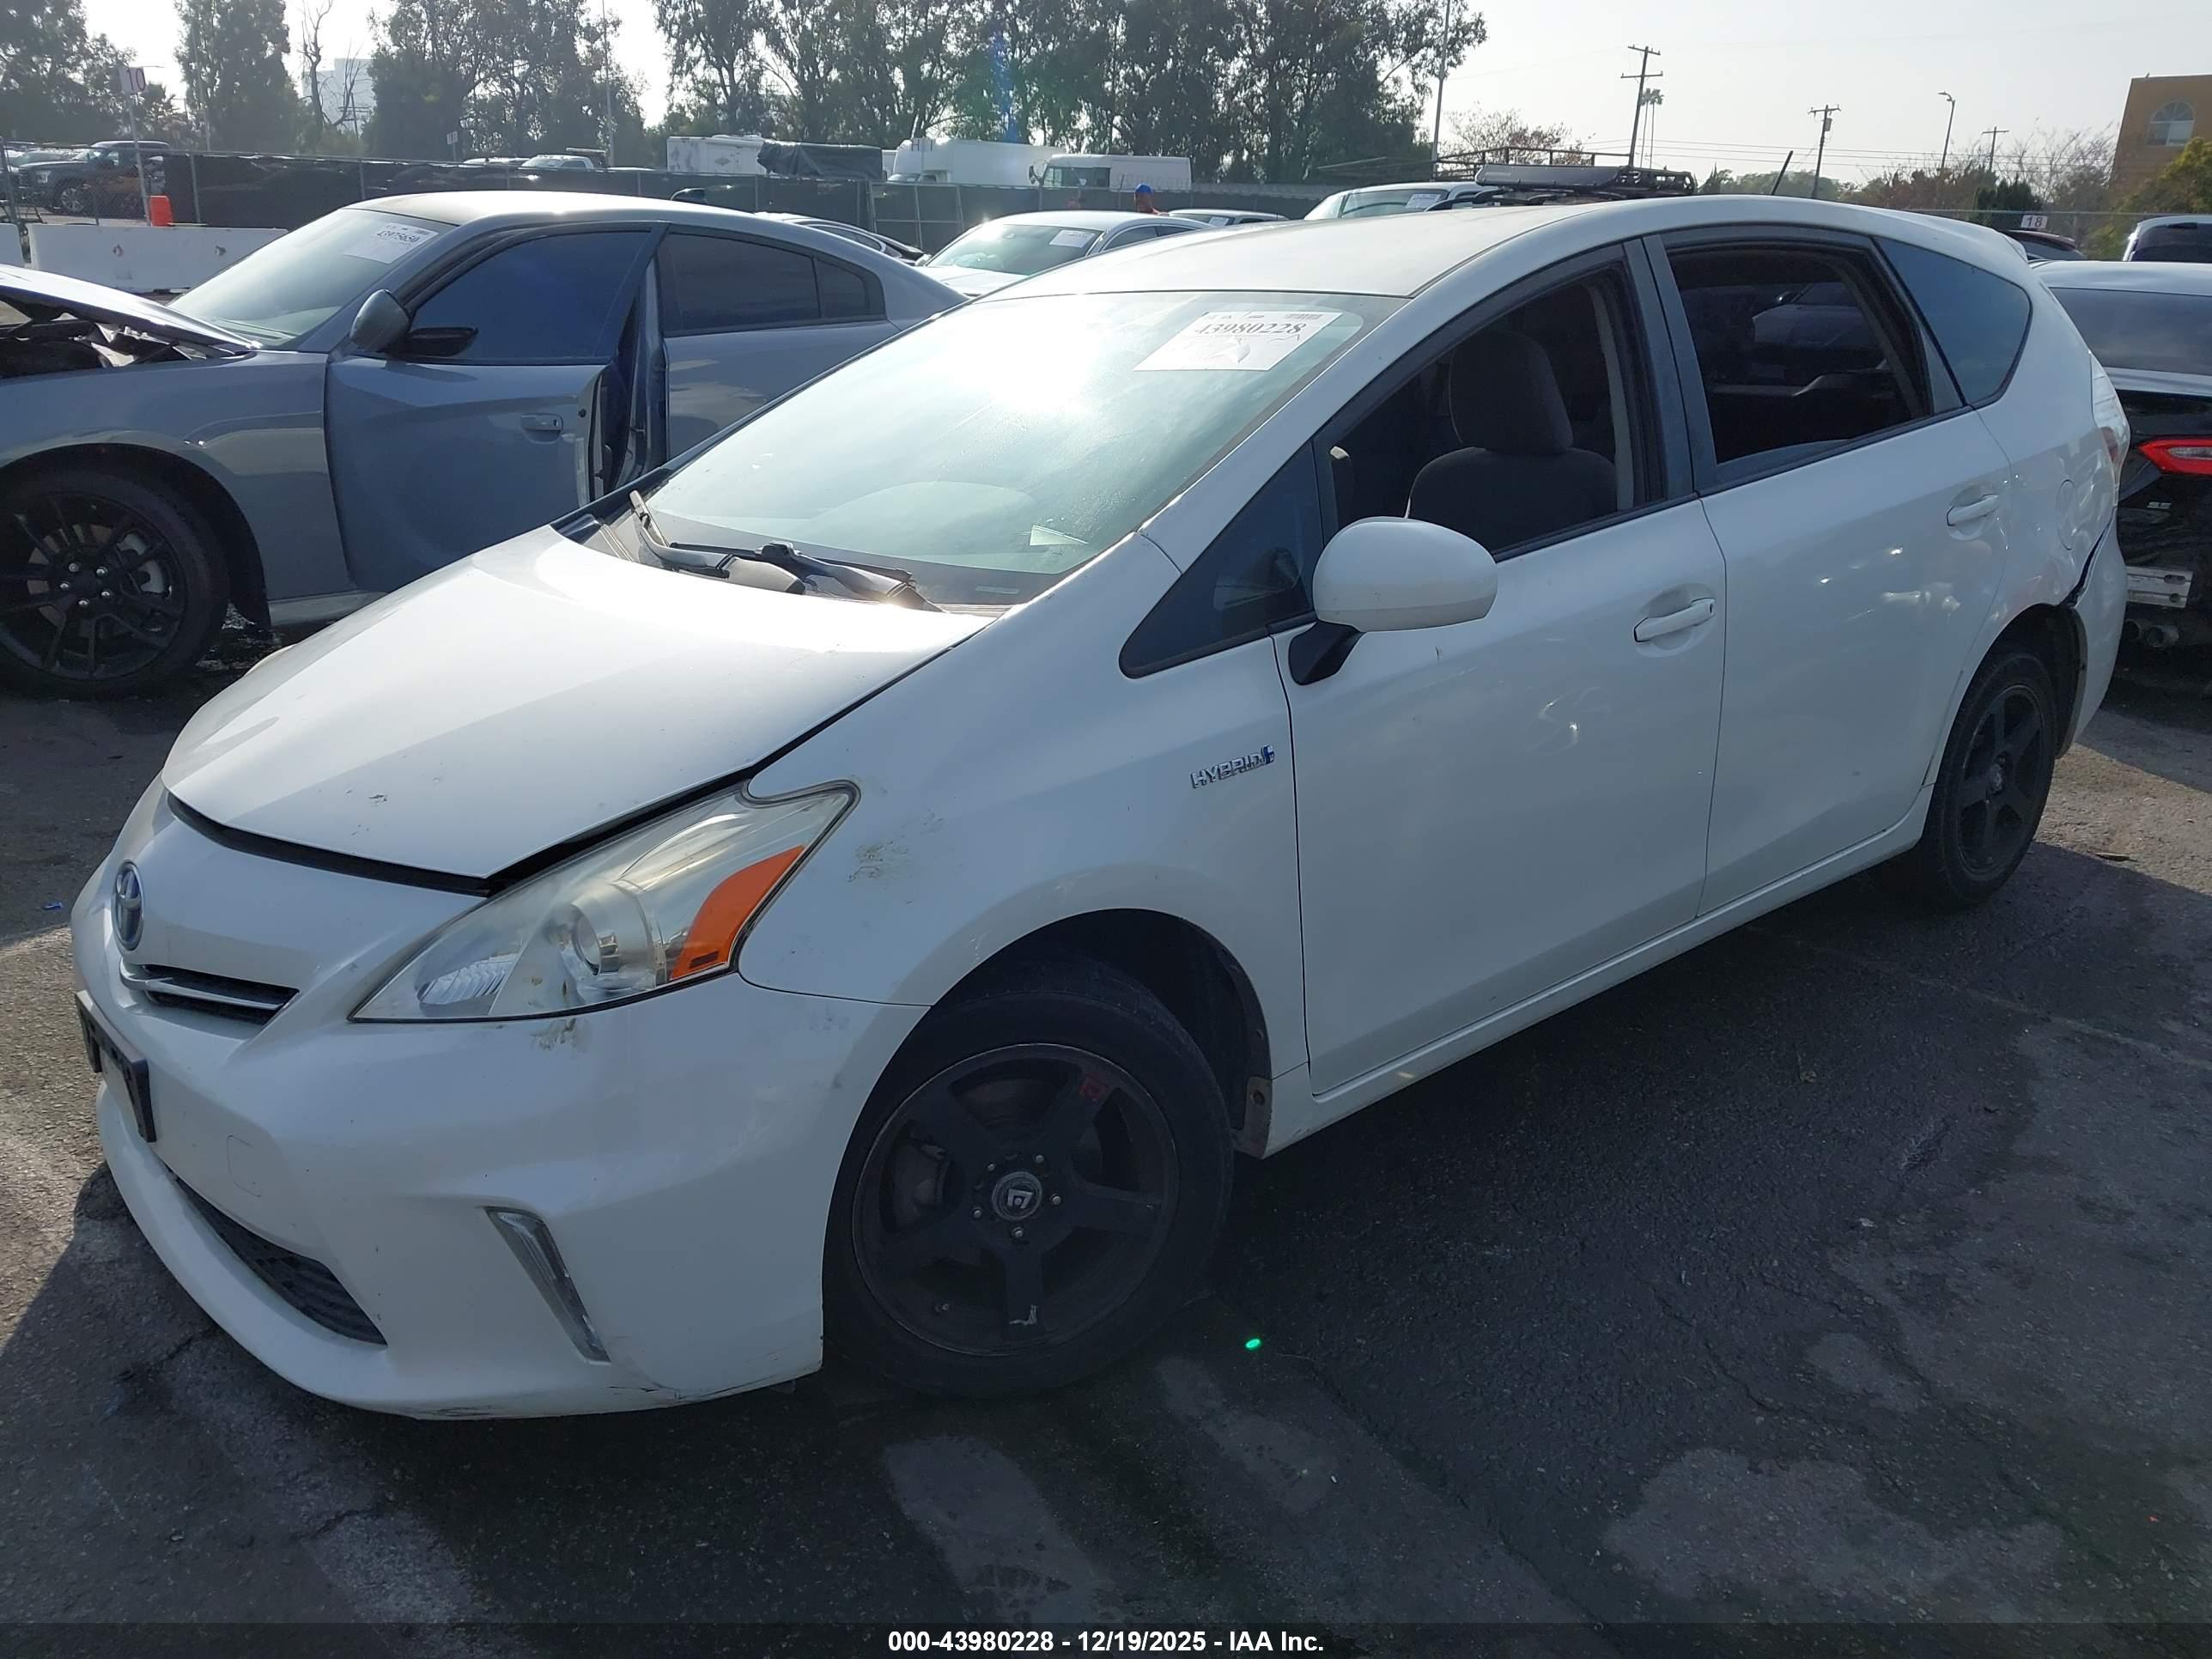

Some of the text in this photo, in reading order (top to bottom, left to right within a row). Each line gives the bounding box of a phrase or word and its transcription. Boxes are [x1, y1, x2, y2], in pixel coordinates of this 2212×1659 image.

[126, 68, 146, 91] 10
[2026, 216, 2043, 228] 18
[1194, 322, 1308, 335] 43980228
